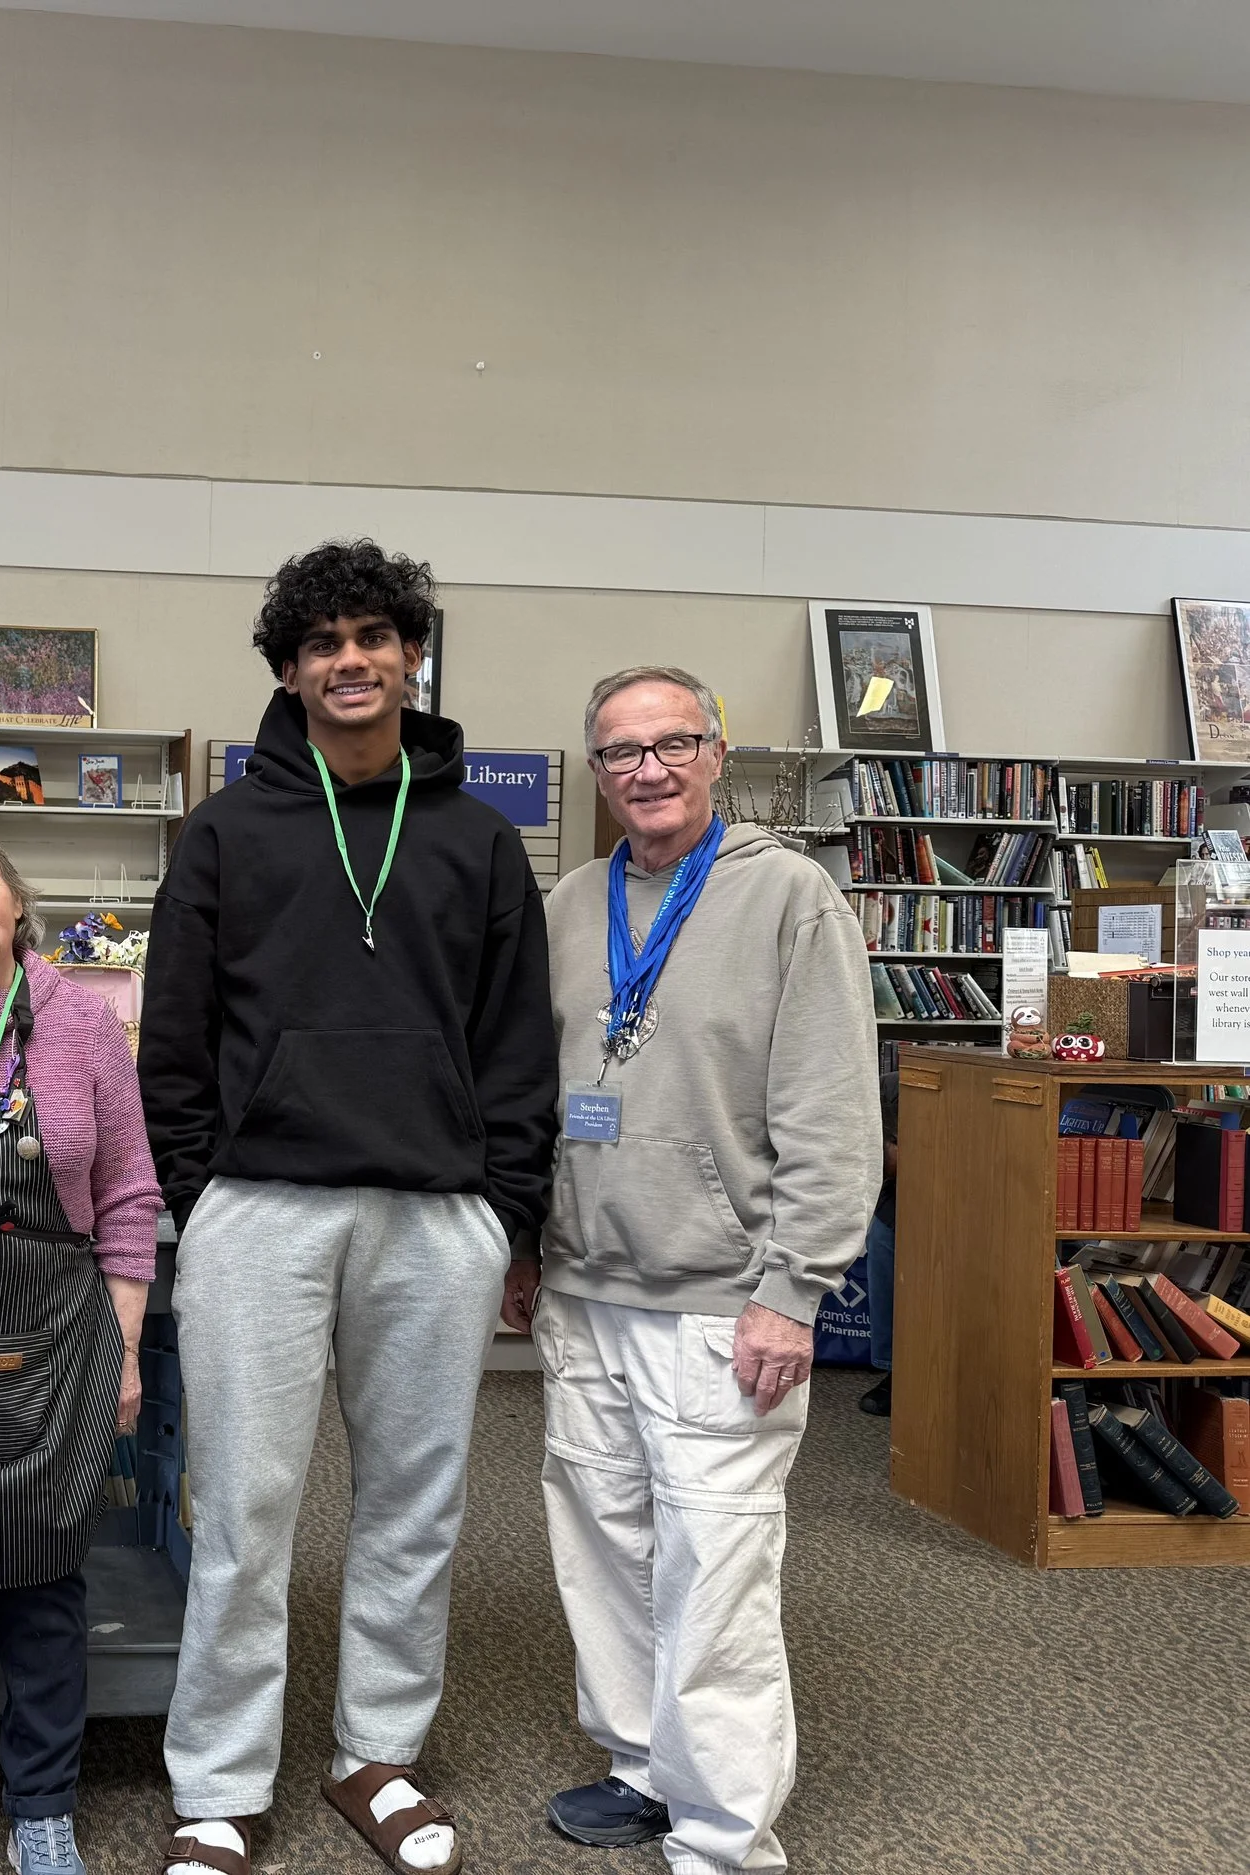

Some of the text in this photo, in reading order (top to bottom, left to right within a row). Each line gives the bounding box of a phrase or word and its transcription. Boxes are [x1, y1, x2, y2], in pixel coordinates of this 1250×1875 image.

[465, 765, 537, 788] Library
[1207, 947, 1231, 959] Shop
[1210, 972, 1250, 982] Our store
[1231, 988, 1249, 997] wall
[1212, 1018, 1242, 1030] library
[581, 1103, 609, 1113] Stephen
[1060, 1114, 1090, 1131] LIGHTEN
[817, 1310, 852, 1323] sam's
[822, 1322, 872, 1338] Pharmac
[414, 1832, 440, 1845] DRI-FIT
